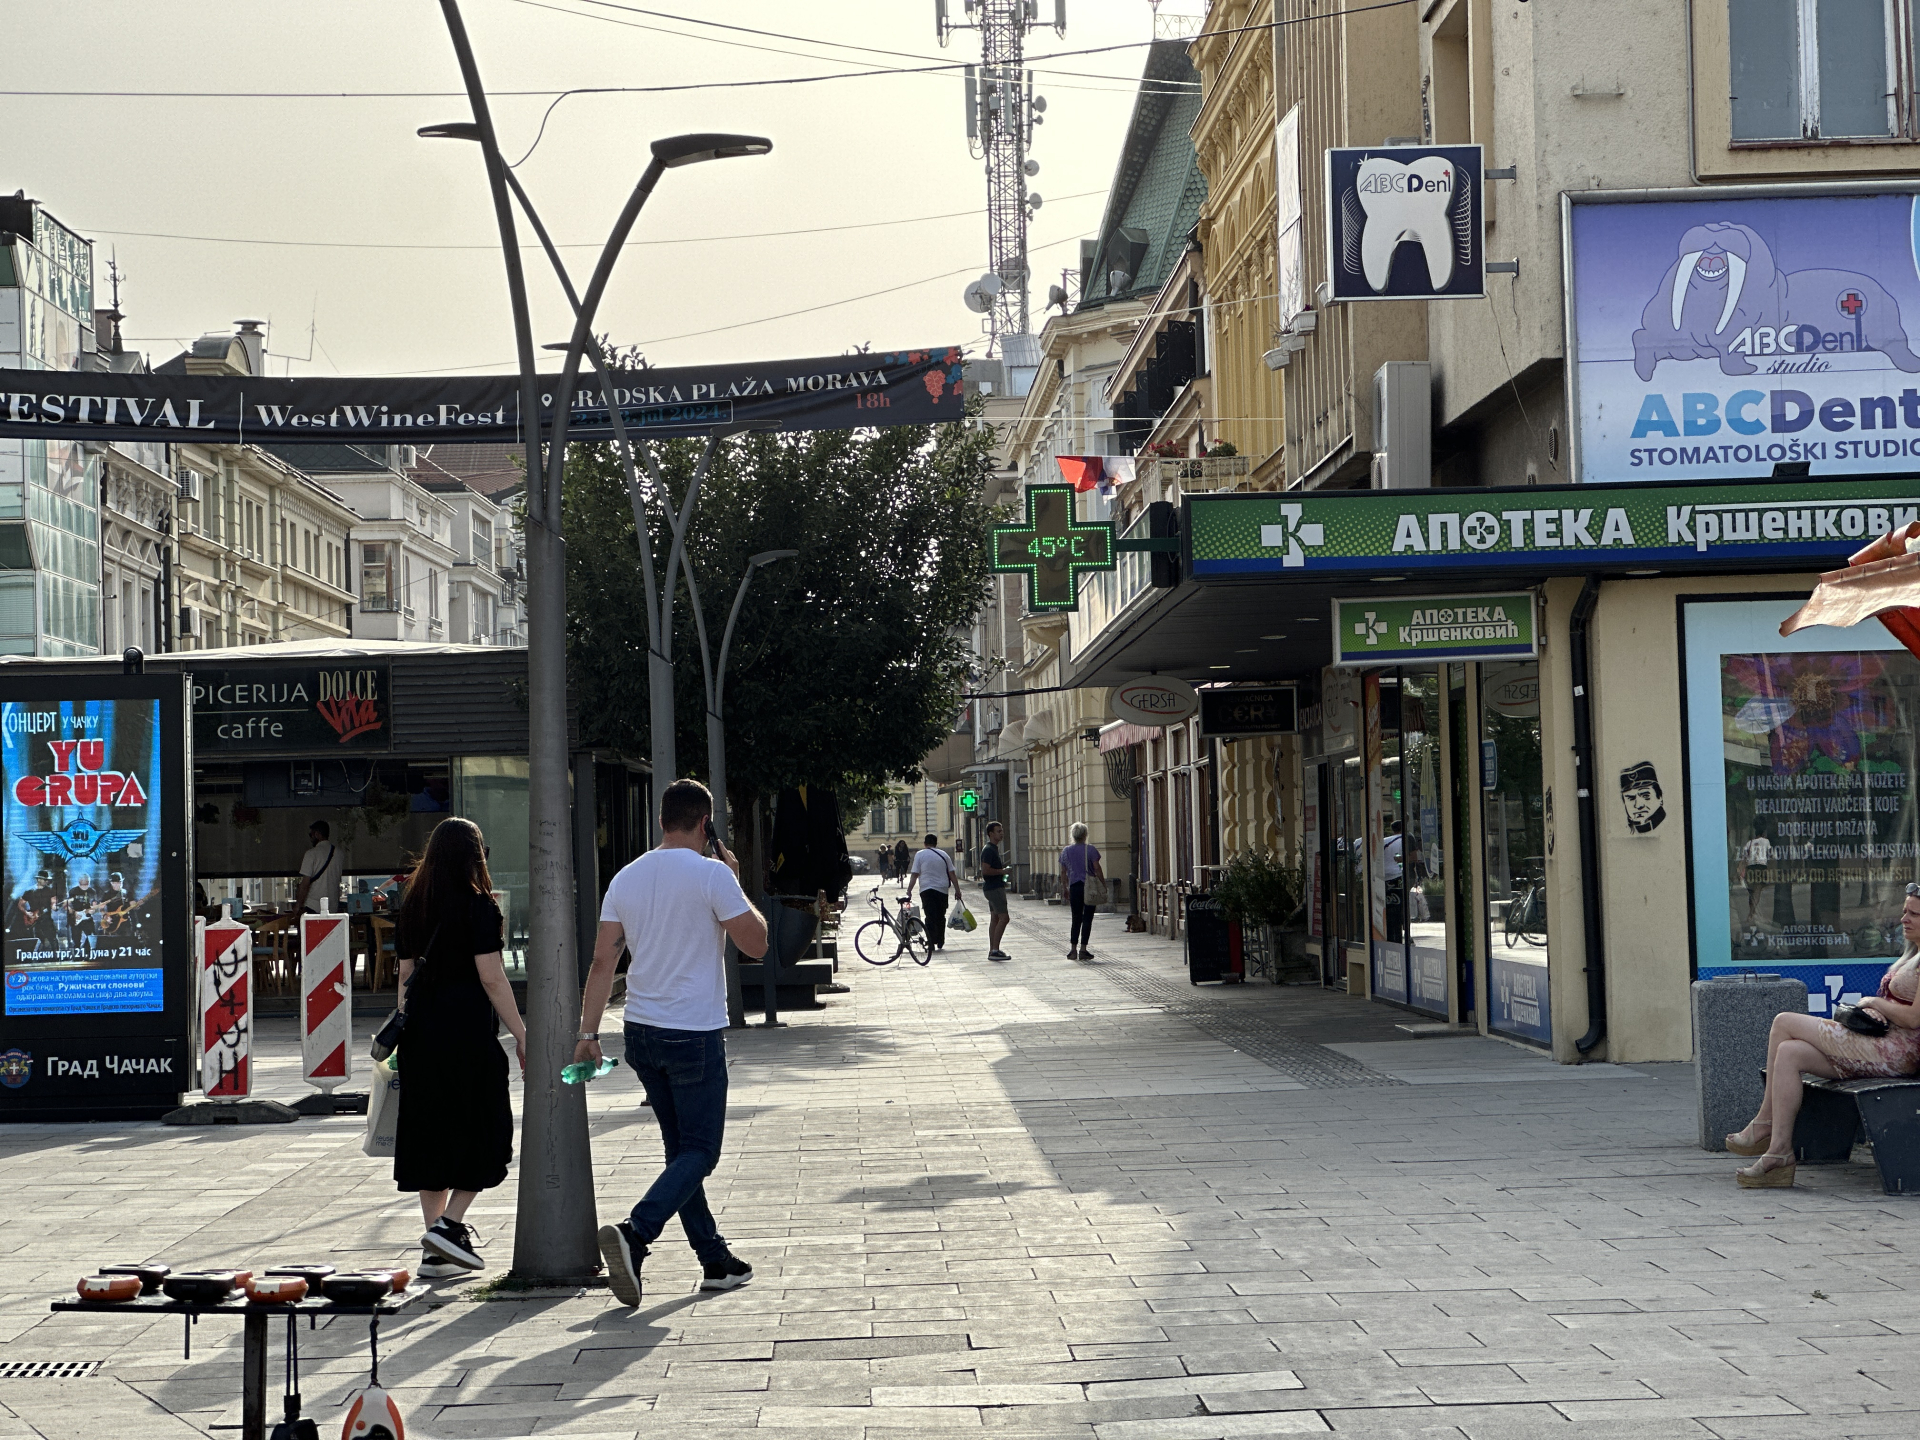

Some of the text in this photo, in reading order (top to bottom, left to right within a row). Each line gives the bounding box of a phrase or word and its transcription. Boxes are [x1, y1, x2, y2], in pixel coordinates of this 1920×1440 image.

[1766, 353, 1832, 374] studio
[0, 370, 888, 428] ESTIVAL WestWineFest RADSKA PLAŽA MORAVA
[856, 393, 890, 409] 18h
[639, 409, 664, 426] jul
[669, 405, 726, 421] 2024.
[1630, 389, 1920, 438] ABCDent
[1630, 438, 1826, 466] STOMATOLOŠKI
[1392, 508, 1635, 551] АПОТЕКА
[1028, 536, 1084, 557] 45°C
[1412, 606, 1507, 625] АПОТЕКА
[1399, 620, 1518, 646] Кршенковић
[193, 683, 308, 704] PICERIJA
[319, 670, 378, 701] DOLCE
[1130, 693, 1176, 709] GERSA
[71, 716, 98, 728] ЧАЧКУ
[218, 717, 283, 739] caffe
[47, 738, 104, 772] YU
[12, 771, 147, 806] GRUPA
[1747, 772, 1906, 790] U NAŠIM APOTEKAMA MOŽETE
[1755, 795, 1899, 814] REALIZOVATI VAUČERE KOJE
[1778, 818, 1878, 838] DODELJUJE DRŽAVA
[1812, 844, 1851, 859] LEKOVA
[1747, 868, 1806, 883] OBOLELIMA
[1810, 868, 1824, 882] OD
[1768, 931, 1850, 946] Кршенковић
[1782, 925, 1834, 933] АПОТЕКА
[16, 949, 53, 961] Градски
[56, 949, 72, 960] трг,
[75, 948, 88, 957] 21.
[90, 948, 109, 959] јуна
[111, 949, 117, 959] у
[119, 947, 131, 956] 21
